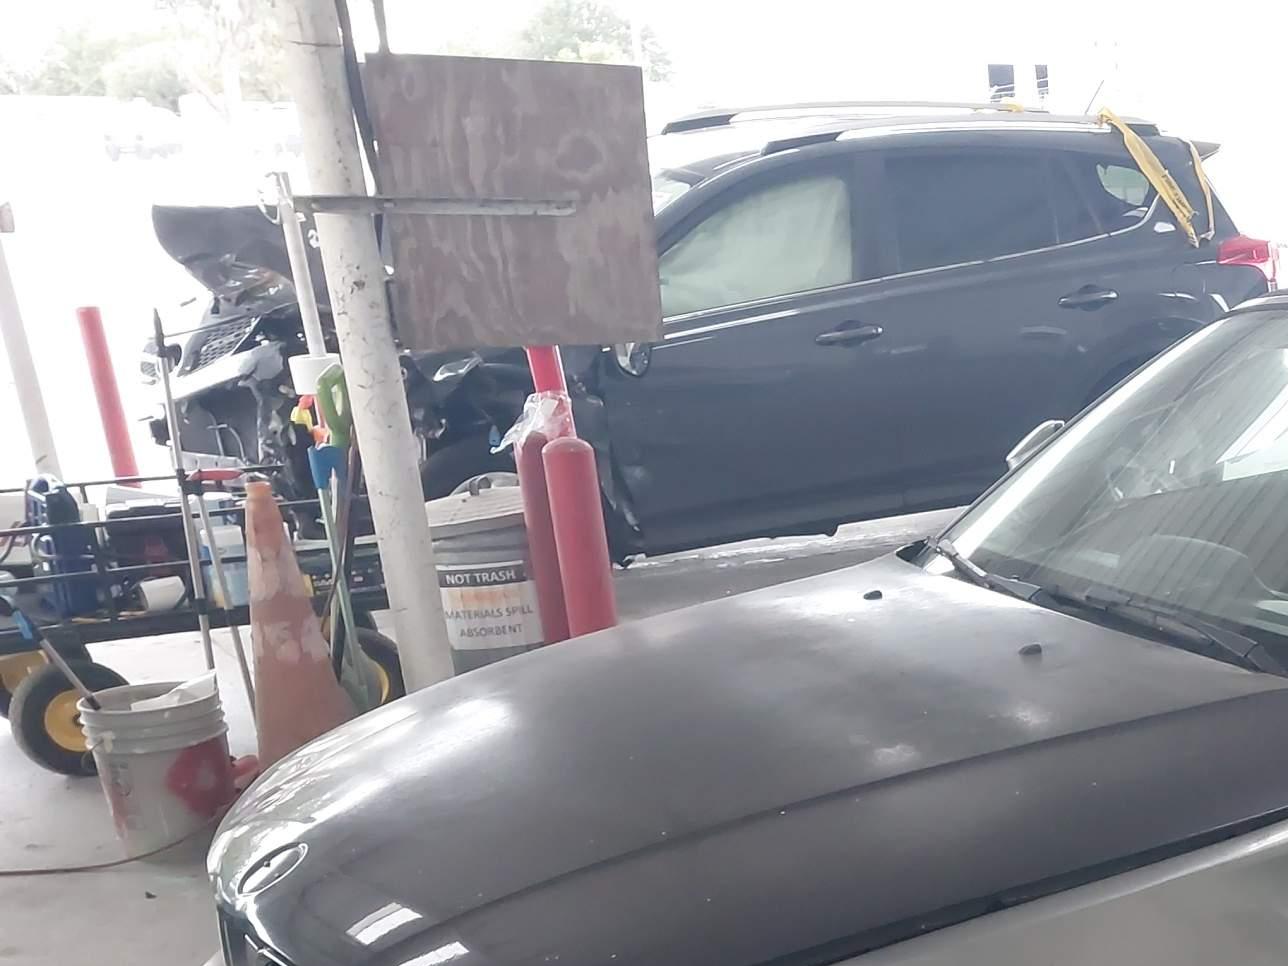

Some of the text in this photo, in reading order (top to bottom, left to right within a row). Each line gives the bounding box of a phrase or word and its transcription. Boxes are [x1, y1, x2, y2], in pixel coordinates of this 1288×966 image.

[446, 570, 516, 585] NOT TRASH
[506, 604, 533, 617] SPILL
[460, 624, 522, 637] ABSORBENT
